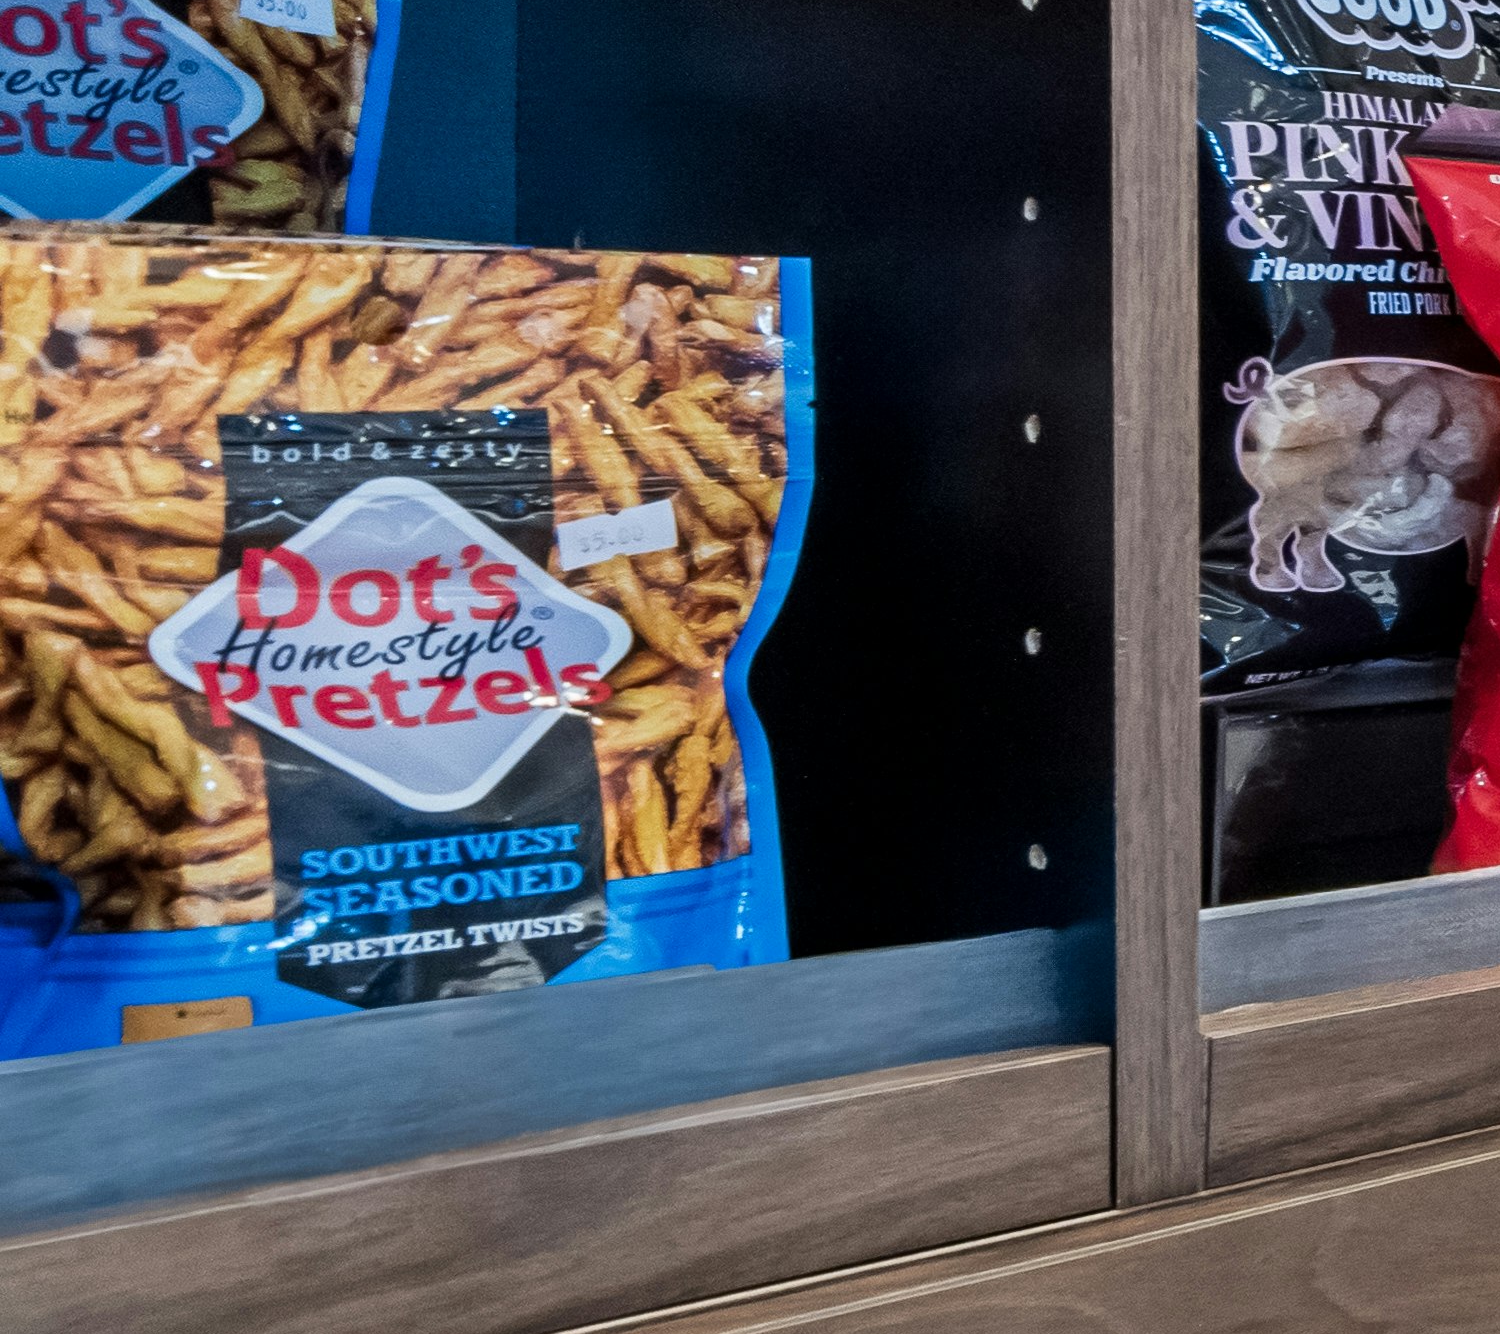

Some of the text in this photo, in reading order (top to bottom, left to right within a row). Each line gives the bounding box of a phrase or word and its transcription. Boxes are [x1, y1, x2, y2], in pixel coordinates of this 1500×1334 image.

[1366, 66, 1445, 89] Presents
[1222, 121, 1414, 185] PINK
[1225, 189, 1290, 250] &
[1250, 258, 1396, 284] Flavored
[1369, 291, 1451, 315] FRIED PORK
[251, 439, 525, 464] bold & zesty
[235, 543, 519, 631] Dot's
[216, 604, 548, 680] Homestyle
[194, 648, 614, 732] Pretzels
[301, 824, 581, 879] SOUTHWEST
[305, 861, 584, 923] SEASONED
[306, 912, 586, 967] PRETZEL TWISTS
